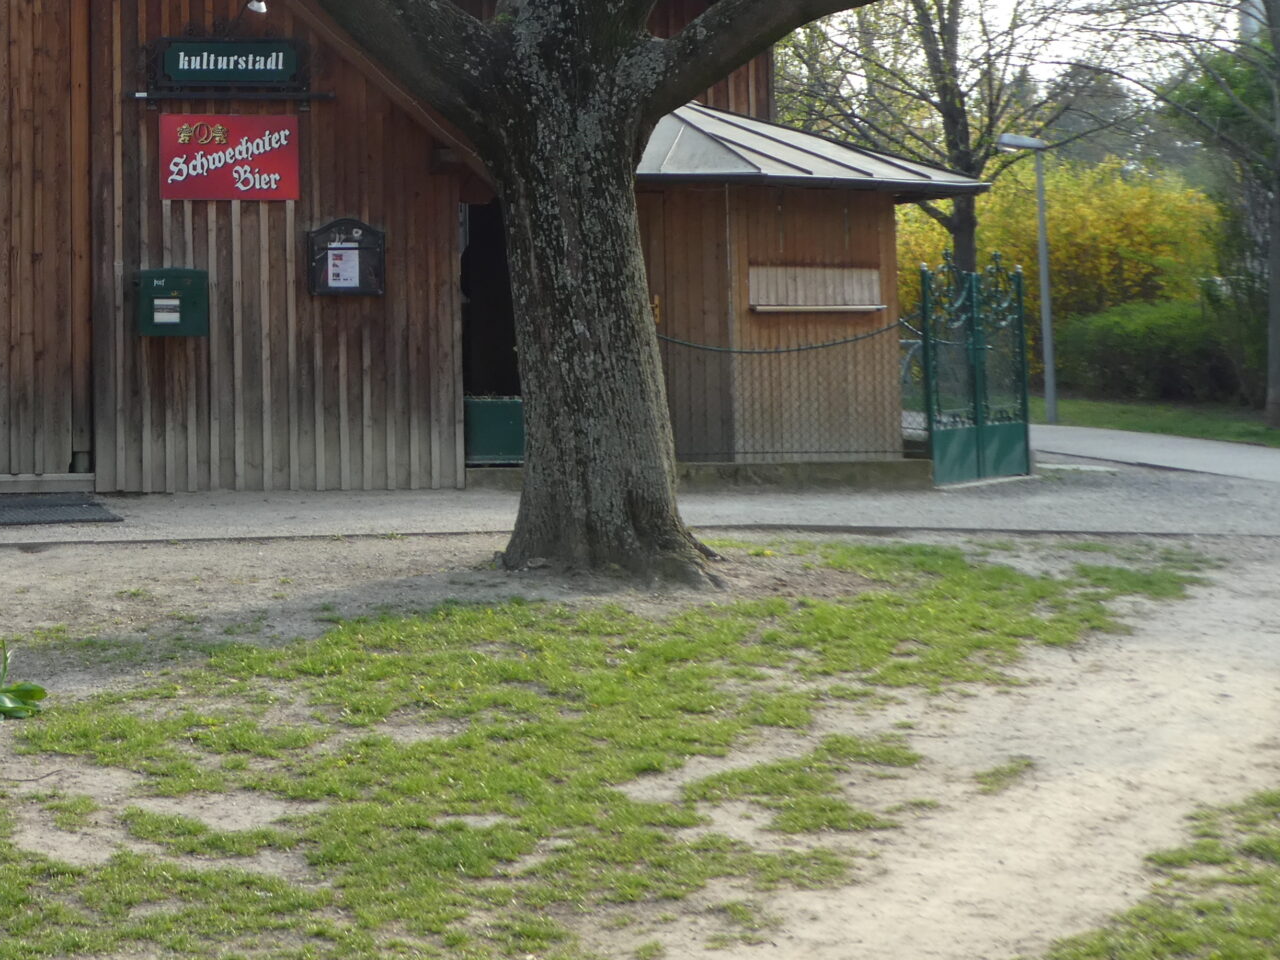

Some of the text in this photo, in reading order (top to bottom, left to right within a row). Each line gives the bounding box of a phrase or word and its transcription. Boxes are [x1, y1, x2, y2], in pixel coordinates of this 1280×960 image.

[178, 51, 284, 70] kulturstadl
[167, 128, 291, 184] Schwechater
[232, 165, 281, 192] Bier
